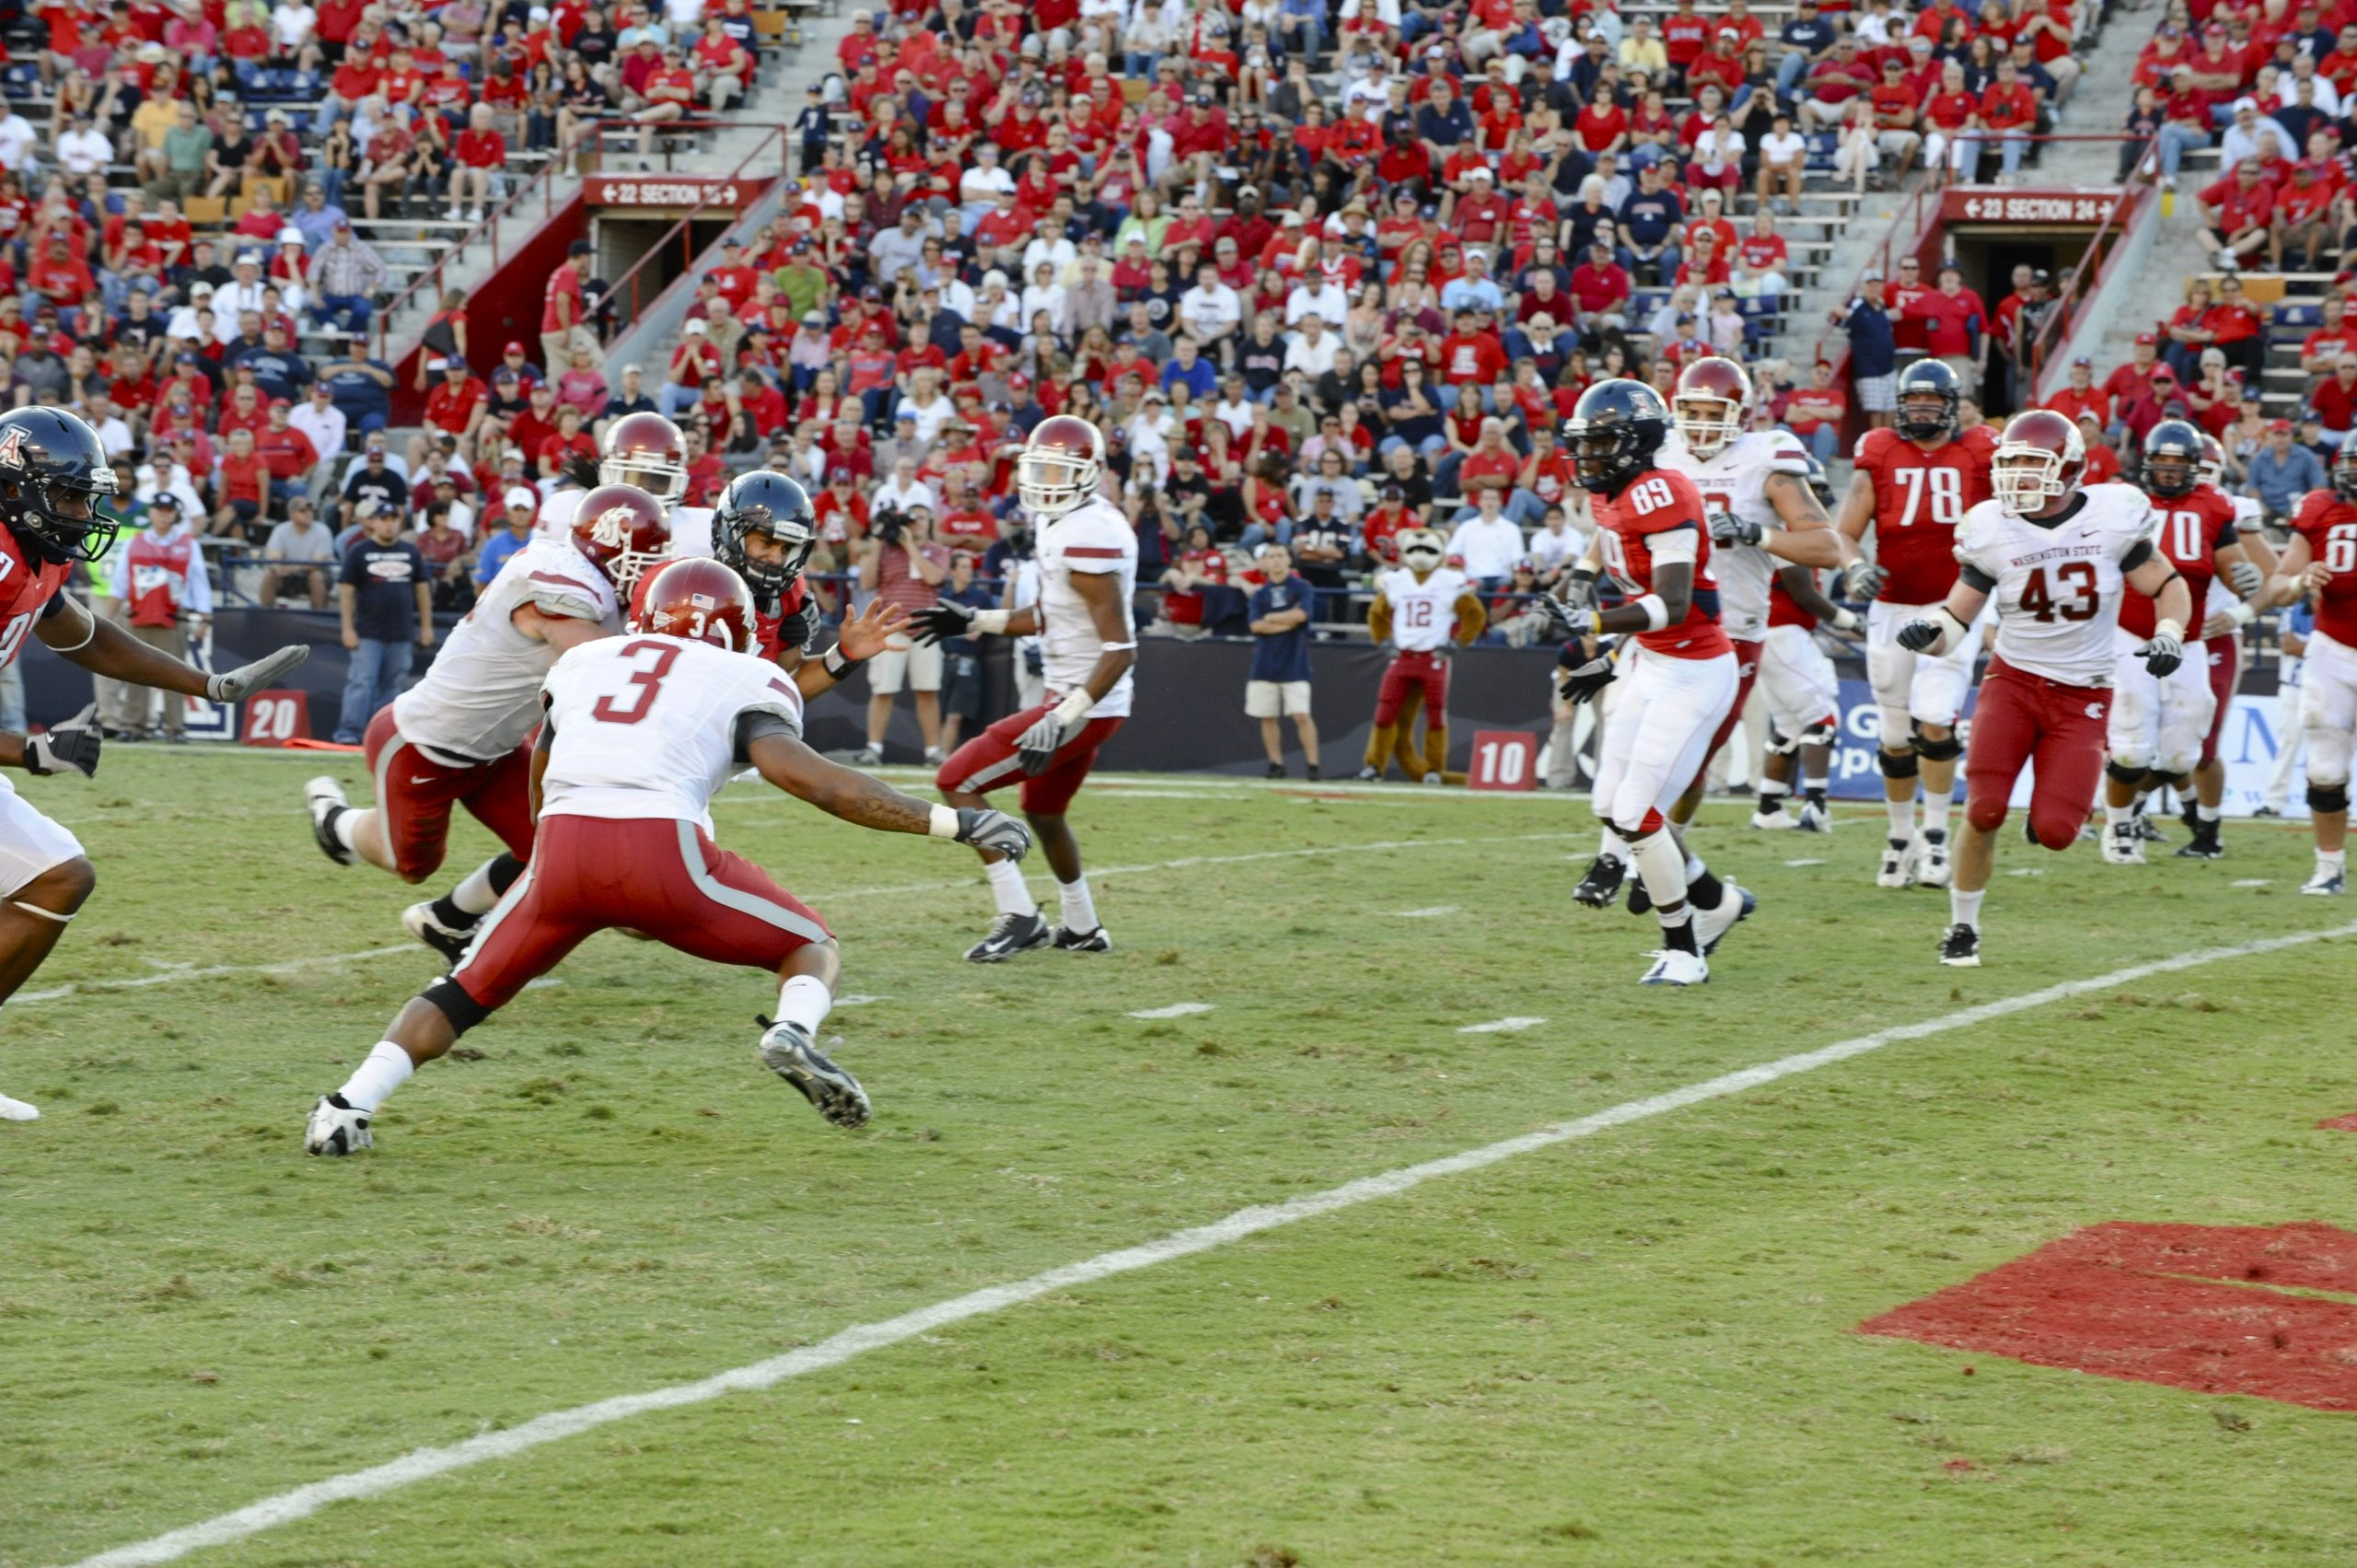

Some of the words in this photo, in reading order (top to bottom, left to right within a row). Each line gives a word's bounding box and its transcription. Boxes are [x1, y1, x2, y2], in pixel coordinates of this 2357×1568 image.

[618, 184, 637, 203] 22
[640, 184, 701, 203] SECTION
[1982, 198, 2003, 218] 23
[2006, 198, 2072, 219] SECTION
[2074, 200, 2096, 220] 24
[1630, 478, 1675, 516] 89
[1895, 467, 1963, 527] 78
[2149, 509, 2202, 561] 70
[2010, 547, 2070, 567] WASHINGTON
[2073, 545, 2102, 556] STATE
[2019, 561, 2099, 623] 43
[689, 612, 706, 637] 3
[1406, 601, 1433, 628] 12
[592, 640, 682, 725] 3
[250, 699, 296, 739] 20
[1480, 742, 1526, 784] 10
